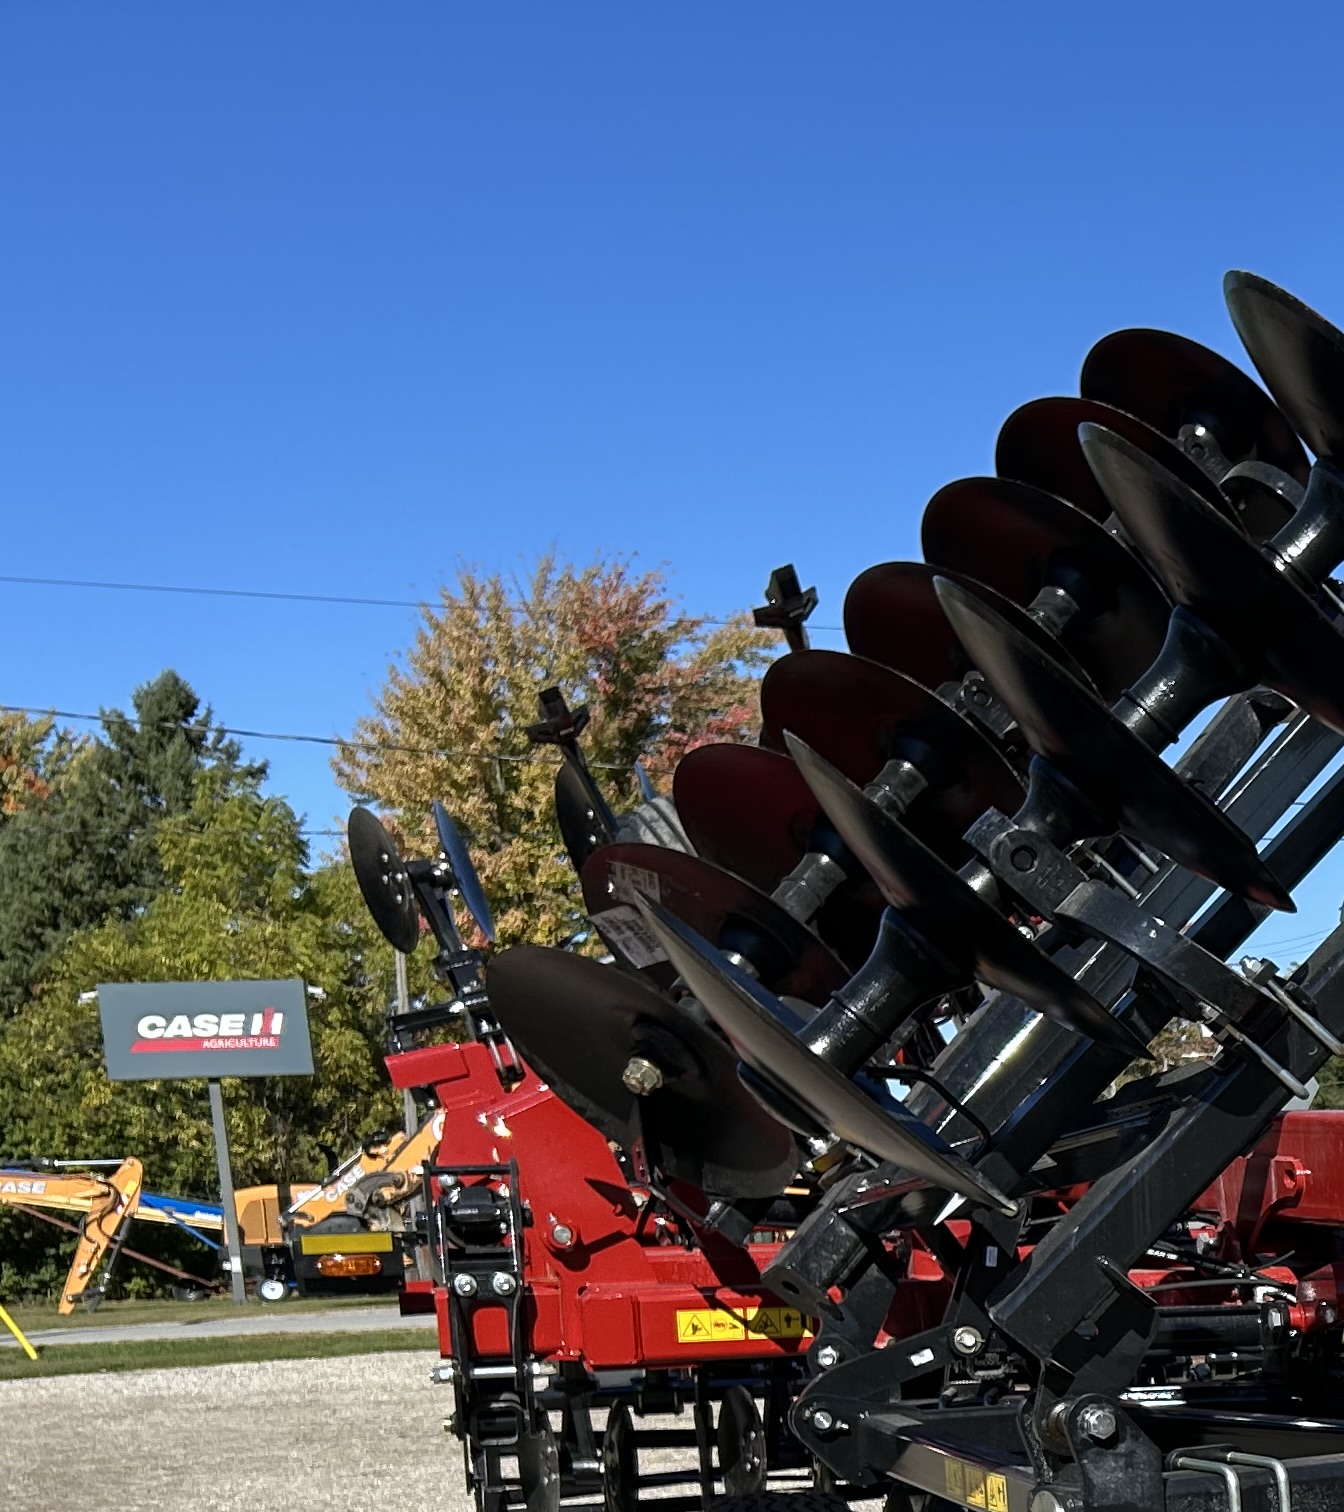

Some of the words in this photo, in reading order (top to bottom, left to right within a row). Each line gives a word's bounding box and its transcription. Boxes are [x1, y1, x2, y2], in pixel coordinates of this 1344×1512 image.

[137, 1013, 246, 1039] CASE
[202, 1037, 277, 1049] AGRICULTURE
[0, 1180, 46, 1195] ASE
[323, 1164, 366, 1203] CASE
